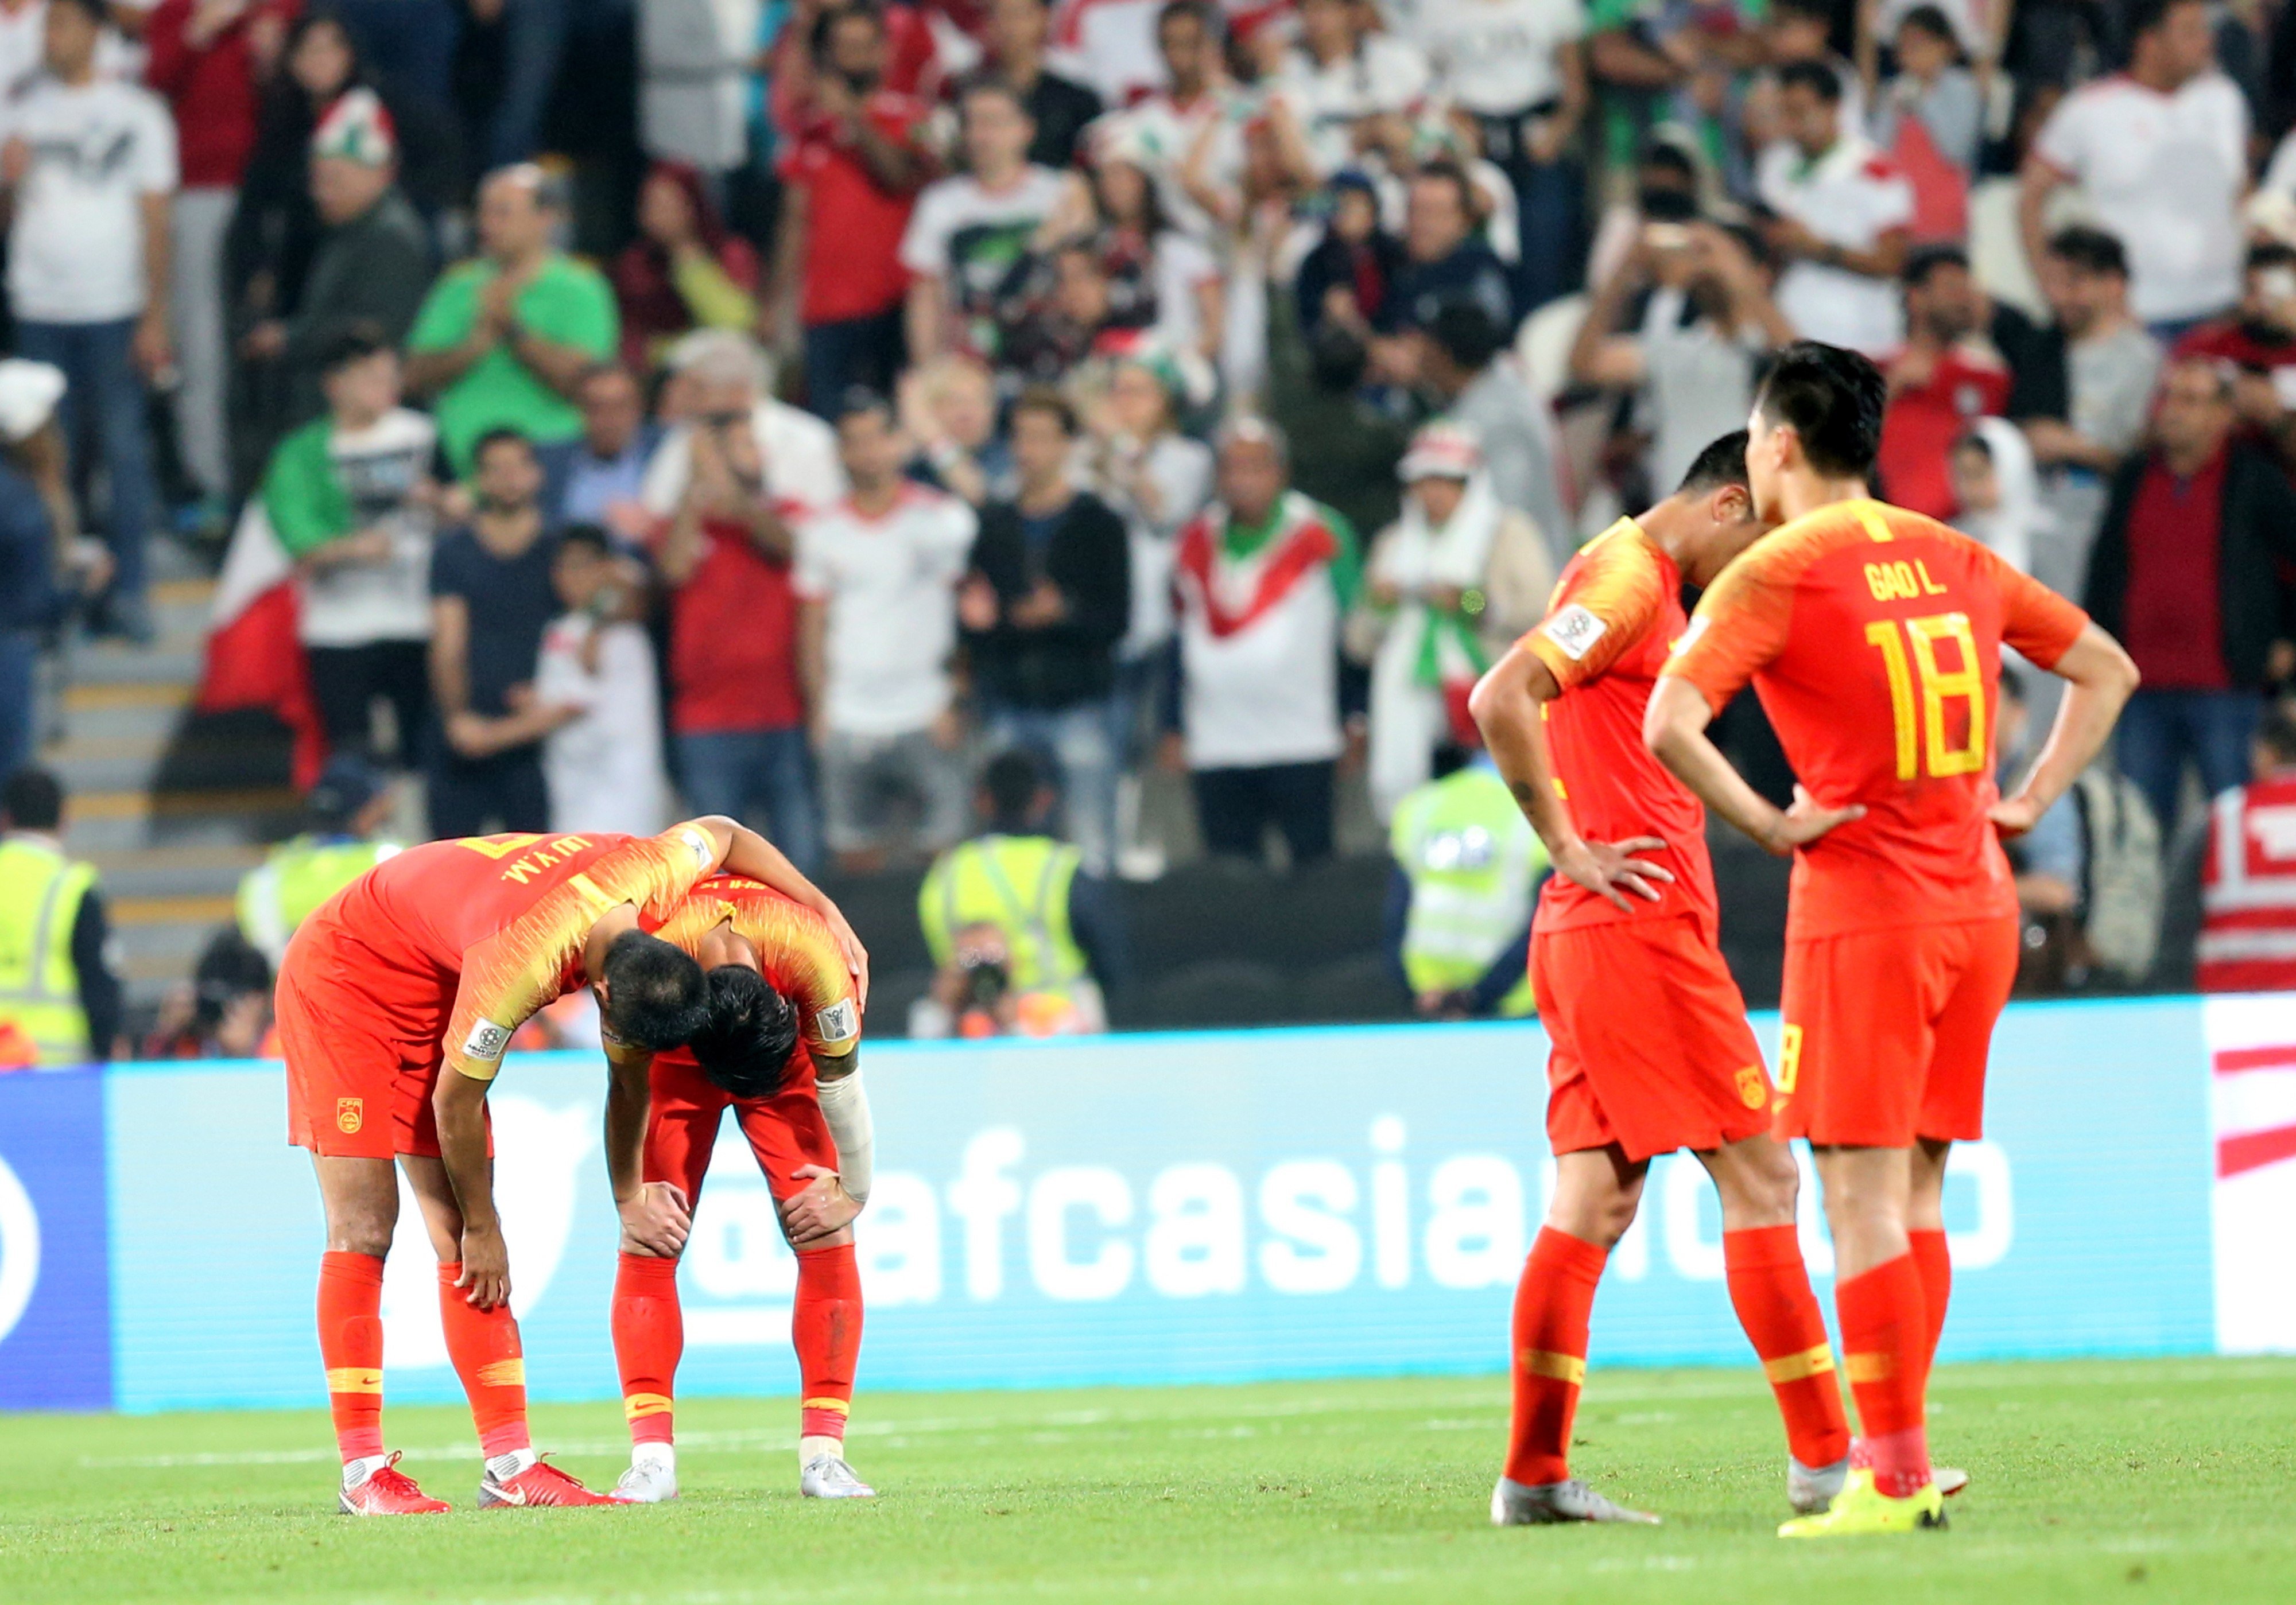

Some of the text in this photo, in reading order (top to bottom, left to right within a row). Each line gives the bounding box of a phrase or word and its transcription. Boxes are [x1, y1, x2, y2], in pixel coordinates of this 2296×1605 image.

[1864, 559, 1919, 601] GAO
[1864, 612, 1985, 780] 18
[682, 1116, 2014, 1344] @afcasiac
